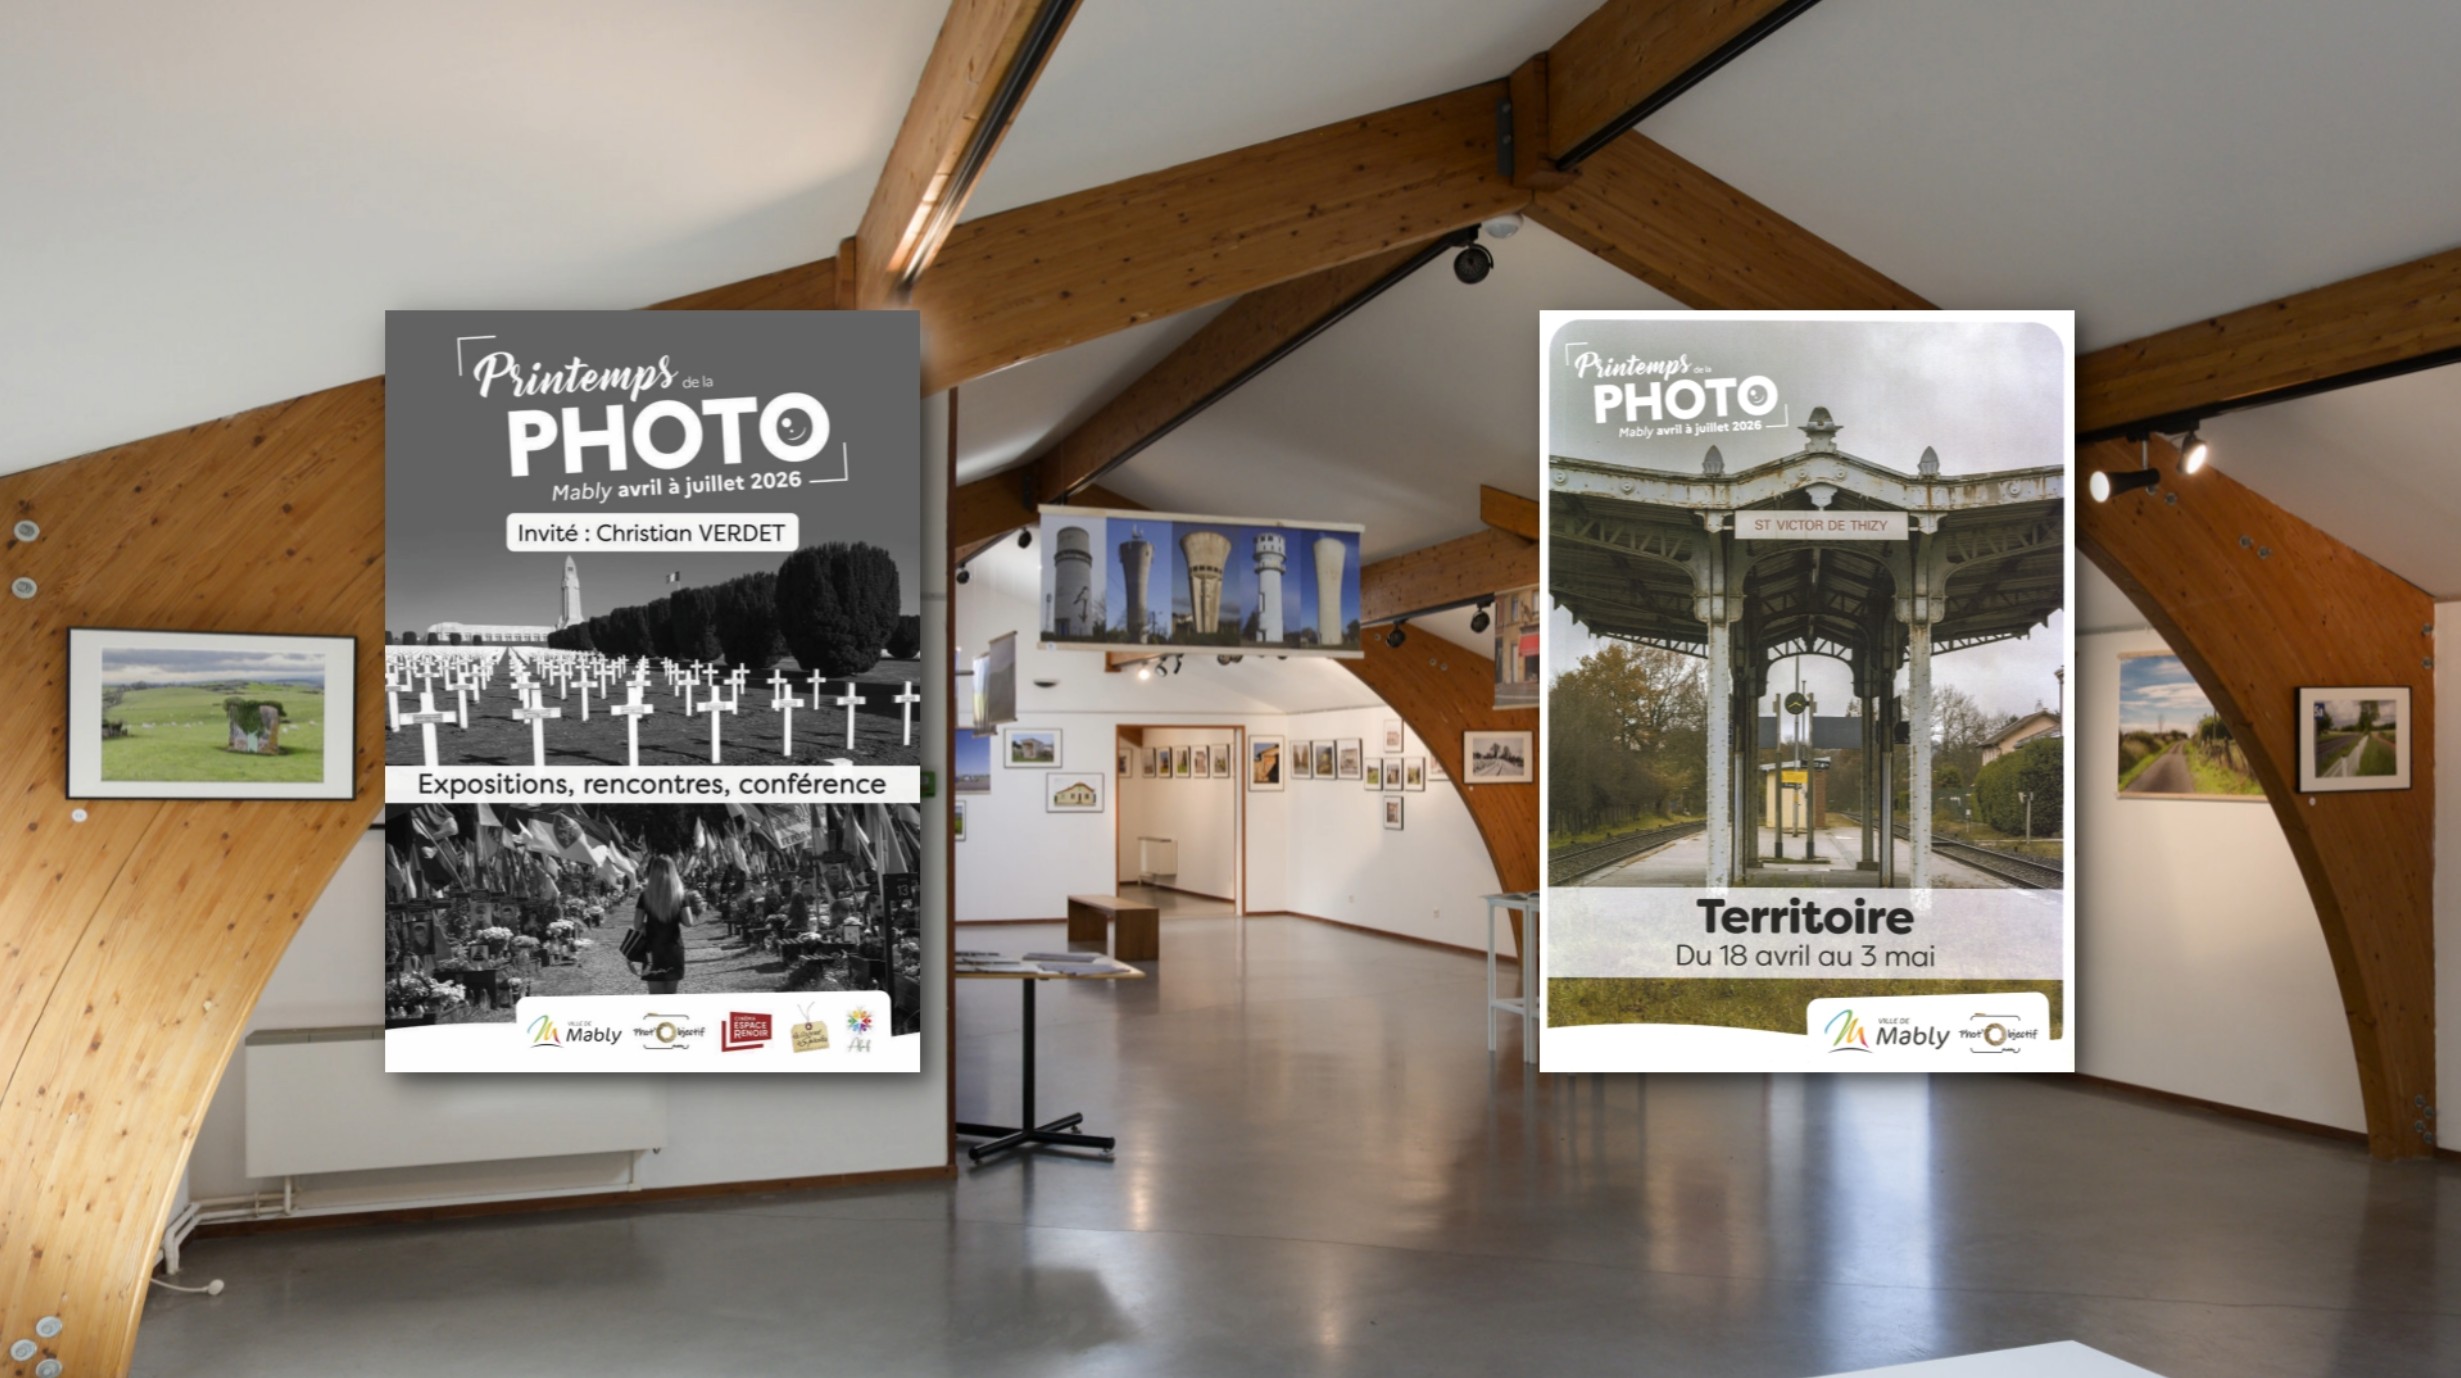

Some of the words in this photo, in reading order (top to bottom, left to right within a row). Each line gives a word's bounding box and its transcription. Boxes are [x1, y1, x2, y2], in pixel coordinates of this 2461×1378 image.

[473, 351, 679, 402] Printemps
[682, 376, 700, 389] de
[702, 376, 714, 388] la
[1574, 351, 1692, 381] Printemps
[1593, 375, 1778, 424] PHOTO
[508, 392, 830, 477] PHOTO
[1618, 426, 1653, 439] Mably
[1656, 424, 1682, 435] avril
[1685, 423, 1692, 434] à
[1694, 422, 1729, 436] juillet
[1732, 420, 1762, 432] 2026
[552, 481, 613, 504] Mably
[618, 478, 662, 498] avril
[668, 477, 680, 494] à
[684, 474, 745, 499] juillet
[750, 470, 802, 490] 2026
[517, 523, 579, 542] Invité
[585, 528, 590, 542] :
[596, 523, 692, 542] Christian
[698, 523, 786, 542] VERDET
[1754, 519, 1771, 531] ST
[1776, 519, 1824, 531] VICTOR
[1828, 520, 1845, 531] DE
[1850, 520, 1888, 531] THIZY
[418, 773, 574, 798] Expositions,
[583, 775, 731, 796] rencontres,
[739, 772, 887, 795] conférence
[1696, 897, 1915, 935] Territoire
[1676, 944, 1711, 967] Du
[1719, 944, 1747, 967] 18
[1755, 944, 1810, 967] avril
[1818, 949, 1852, 967] au
[1861, 944, 1877, 967] 3
[1885, 945, 1936, 967] mai
[734, 1021, 767, 1029] ESPACE
[1899, 1017, 1910, 1025] DE
[566, 1027, 622, 1045] Mably
[734, 1029, 768, 1039] RENOIR
[1876, 1026, 1951, 1050] Mably
